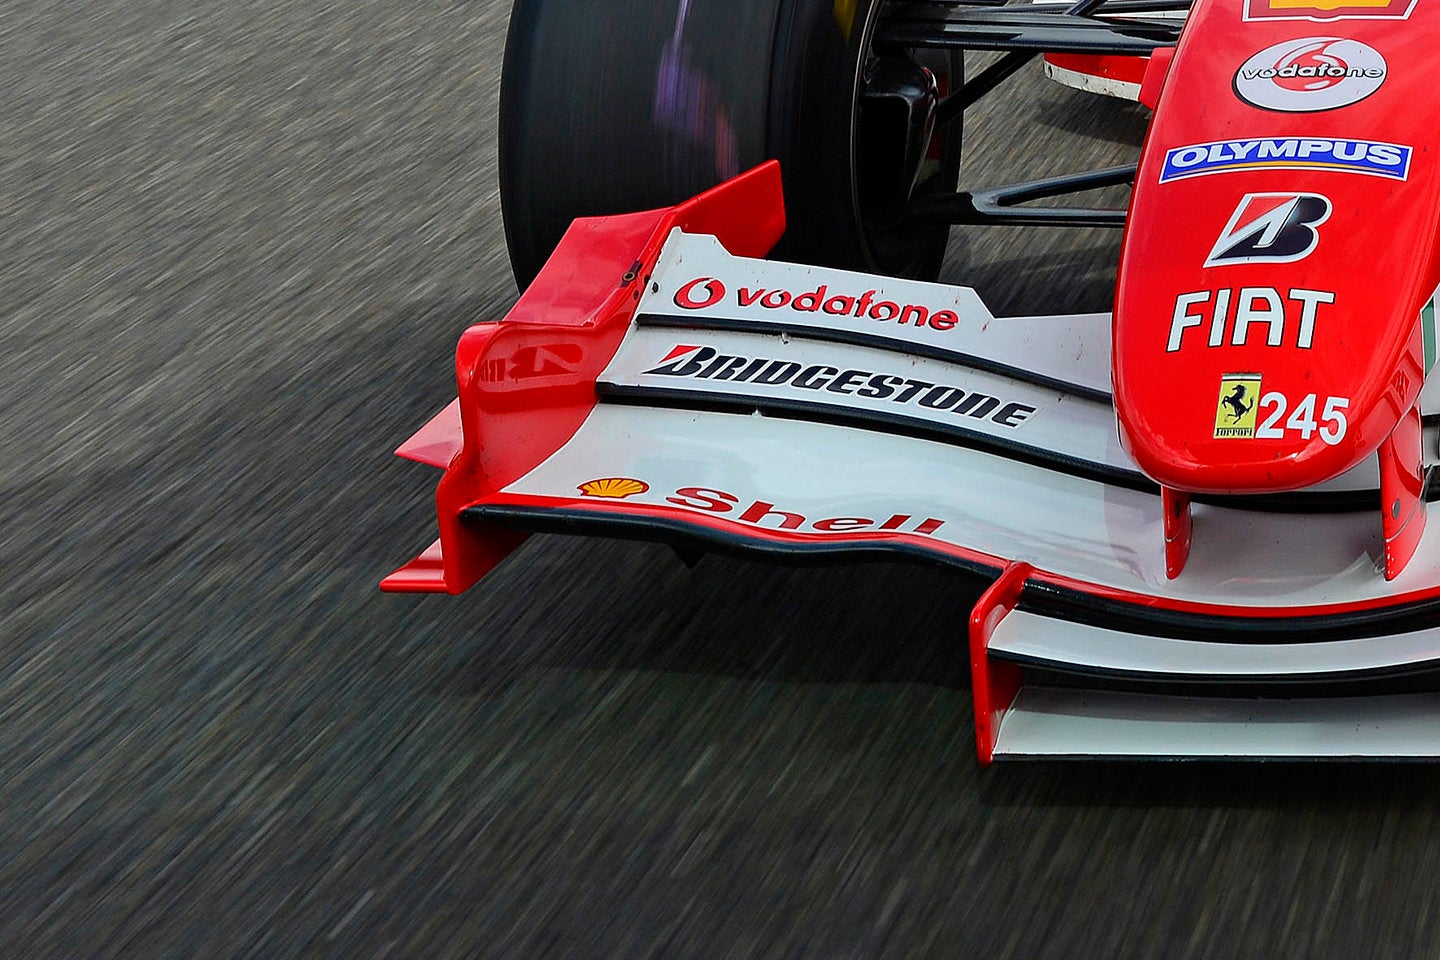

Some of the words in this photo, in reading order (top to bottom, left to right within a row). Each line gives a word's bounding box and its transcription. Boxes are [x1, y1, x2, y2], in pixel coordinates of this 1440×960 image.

[1241, 60, 1384, 80] vodafone
[1170, 139, 1403, 168] OLYMPUS
[736, 283, 960, 331] vodafone
[1166, 287, 1335, 352] FIAT
[641, 344, 1037, 428] BRIDGESTONE
[1254, 391, 1350, 446] 245
[665, 487, 946, 535] Shell
